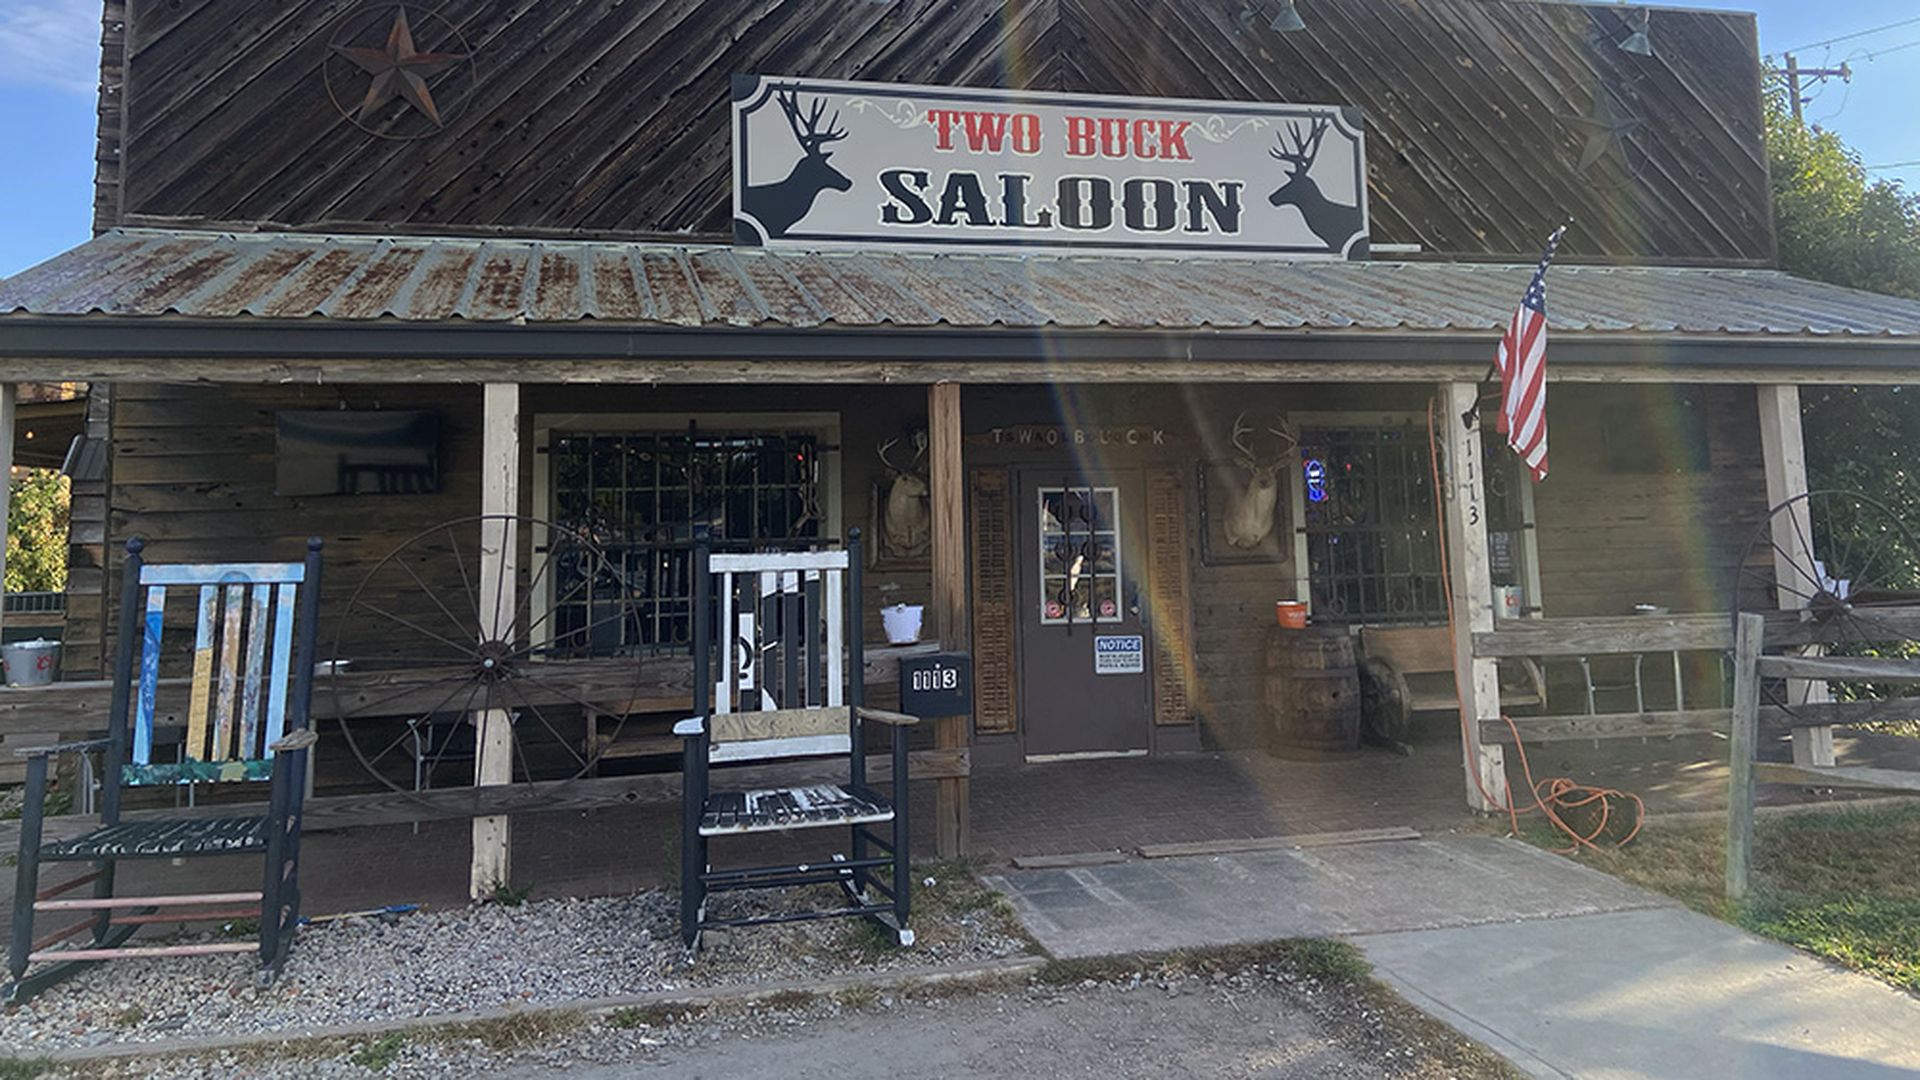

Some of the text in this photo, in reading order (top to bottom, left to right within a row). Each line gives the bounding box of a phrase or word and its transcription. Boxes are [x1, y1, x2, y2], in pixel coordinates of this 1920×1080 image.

[927, 109, 1194, 160] TWO BUCK
[878, 168, 1244, 236] SALOON
[1099, 639, 1139, 650] NOTICE
[913, 669, 957, 690] 1113
